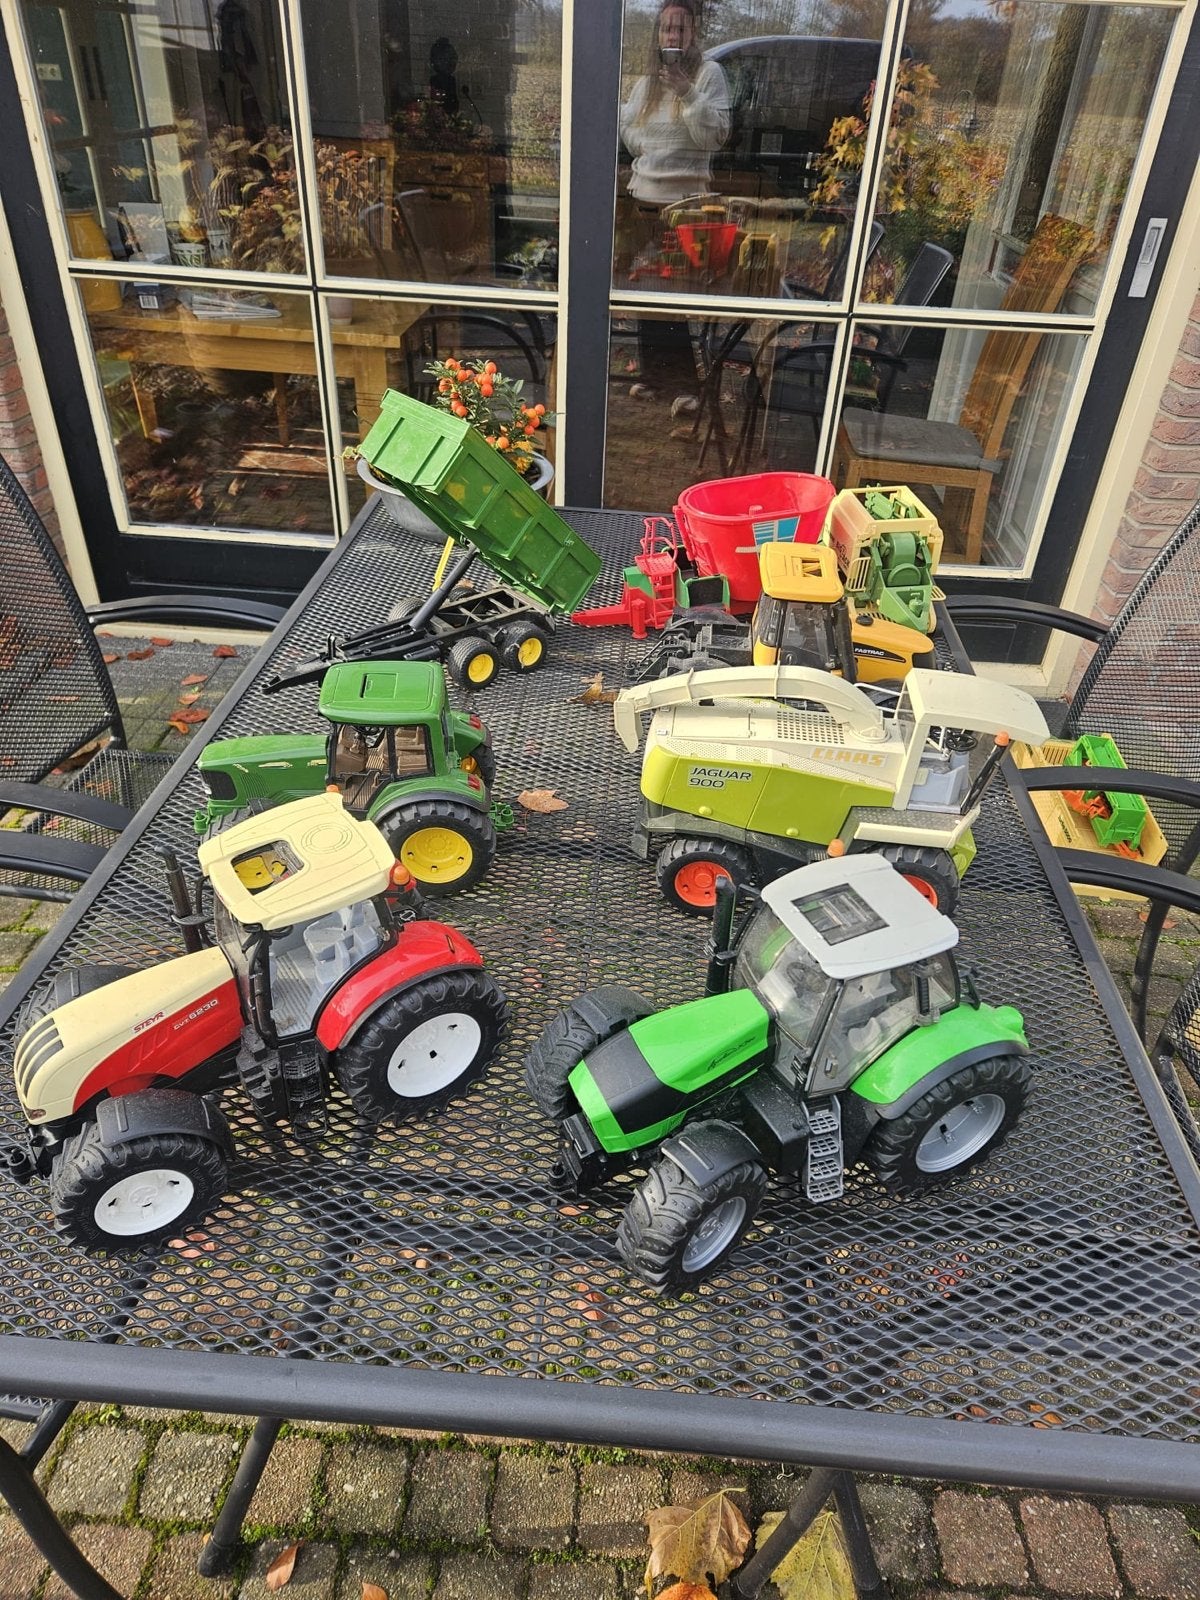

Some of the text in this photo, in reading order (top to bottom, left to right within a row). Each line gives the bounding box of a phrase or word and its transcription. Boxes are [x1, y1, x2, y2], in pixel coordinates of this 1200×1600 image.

[854, 647, 885, 656] FASTRAC
[811, 747, 885, 767] CLAAS
[690, 767, 752, 780] JAGUAR
[689, 777, 725, 788] 900
[133, 1011, 165, 1034] STEYR
